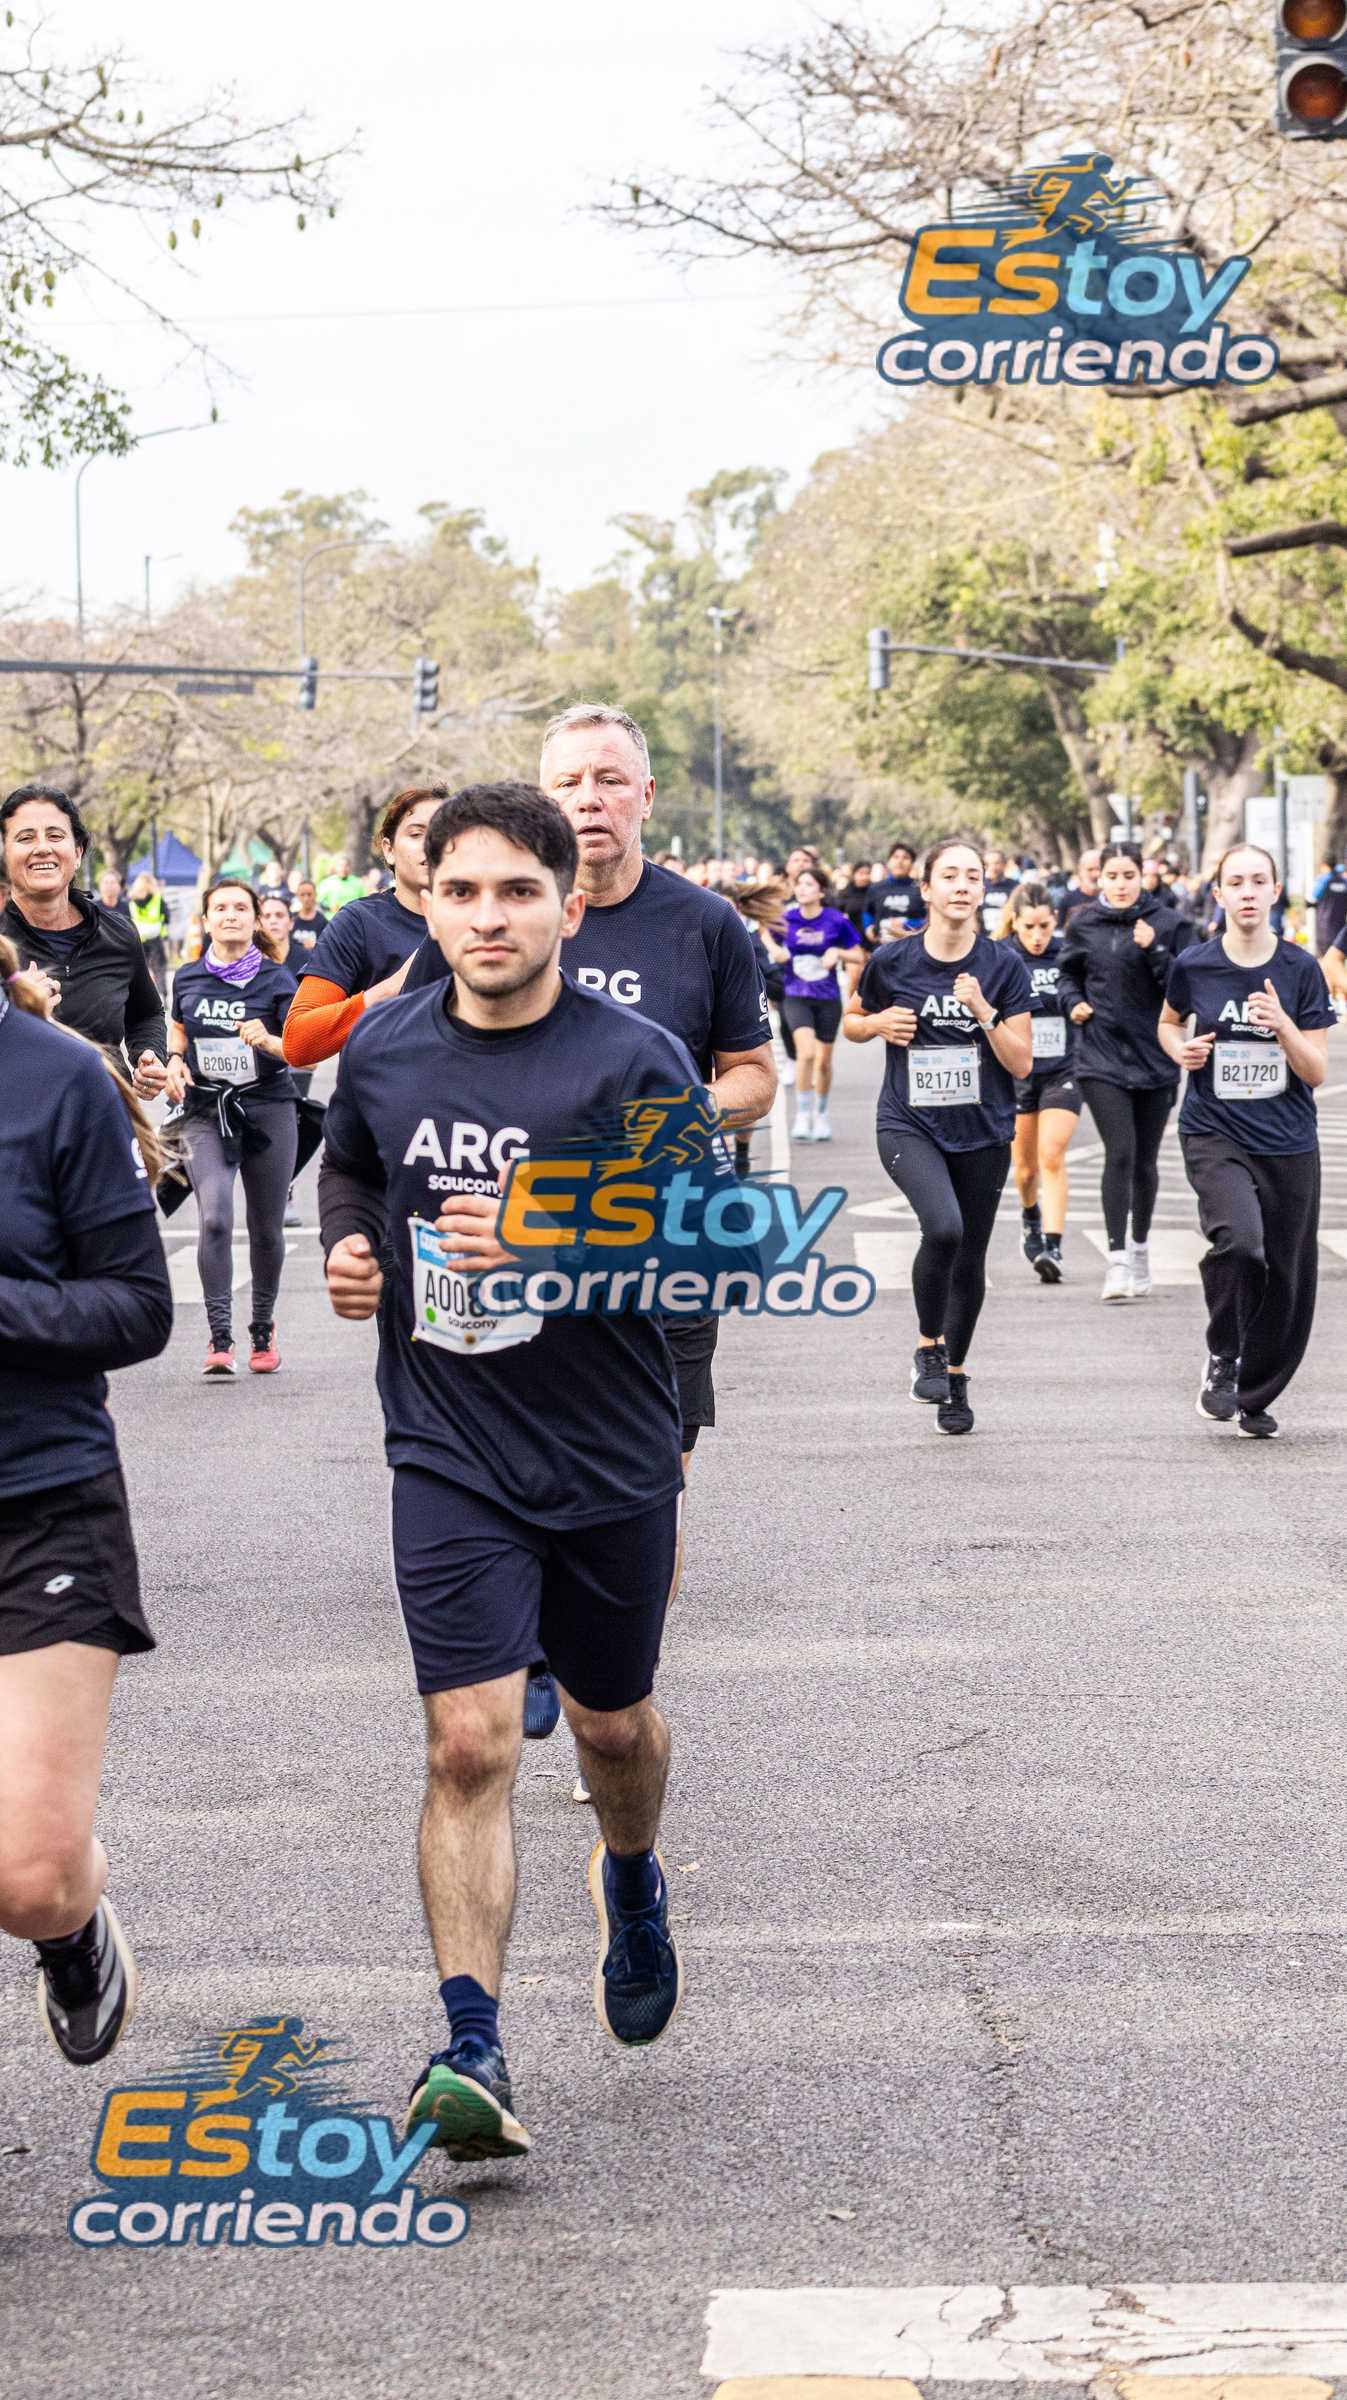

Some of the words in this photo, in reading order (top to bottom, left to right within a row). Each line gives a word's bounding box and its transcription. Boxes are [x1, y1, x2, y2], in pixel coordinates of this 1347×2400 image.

[578, 968, 642, 1005] RG
[194, 998, 246, 1019] ARG
[932, 1019, 971, 1028] saucony
[204, 1056, 248, 1072] B20678
[1222, 1065, 1278, 1081] B21720
[916, 1070, 971, 1089] B21719
[402, 1118, 531, 1177] ARG
